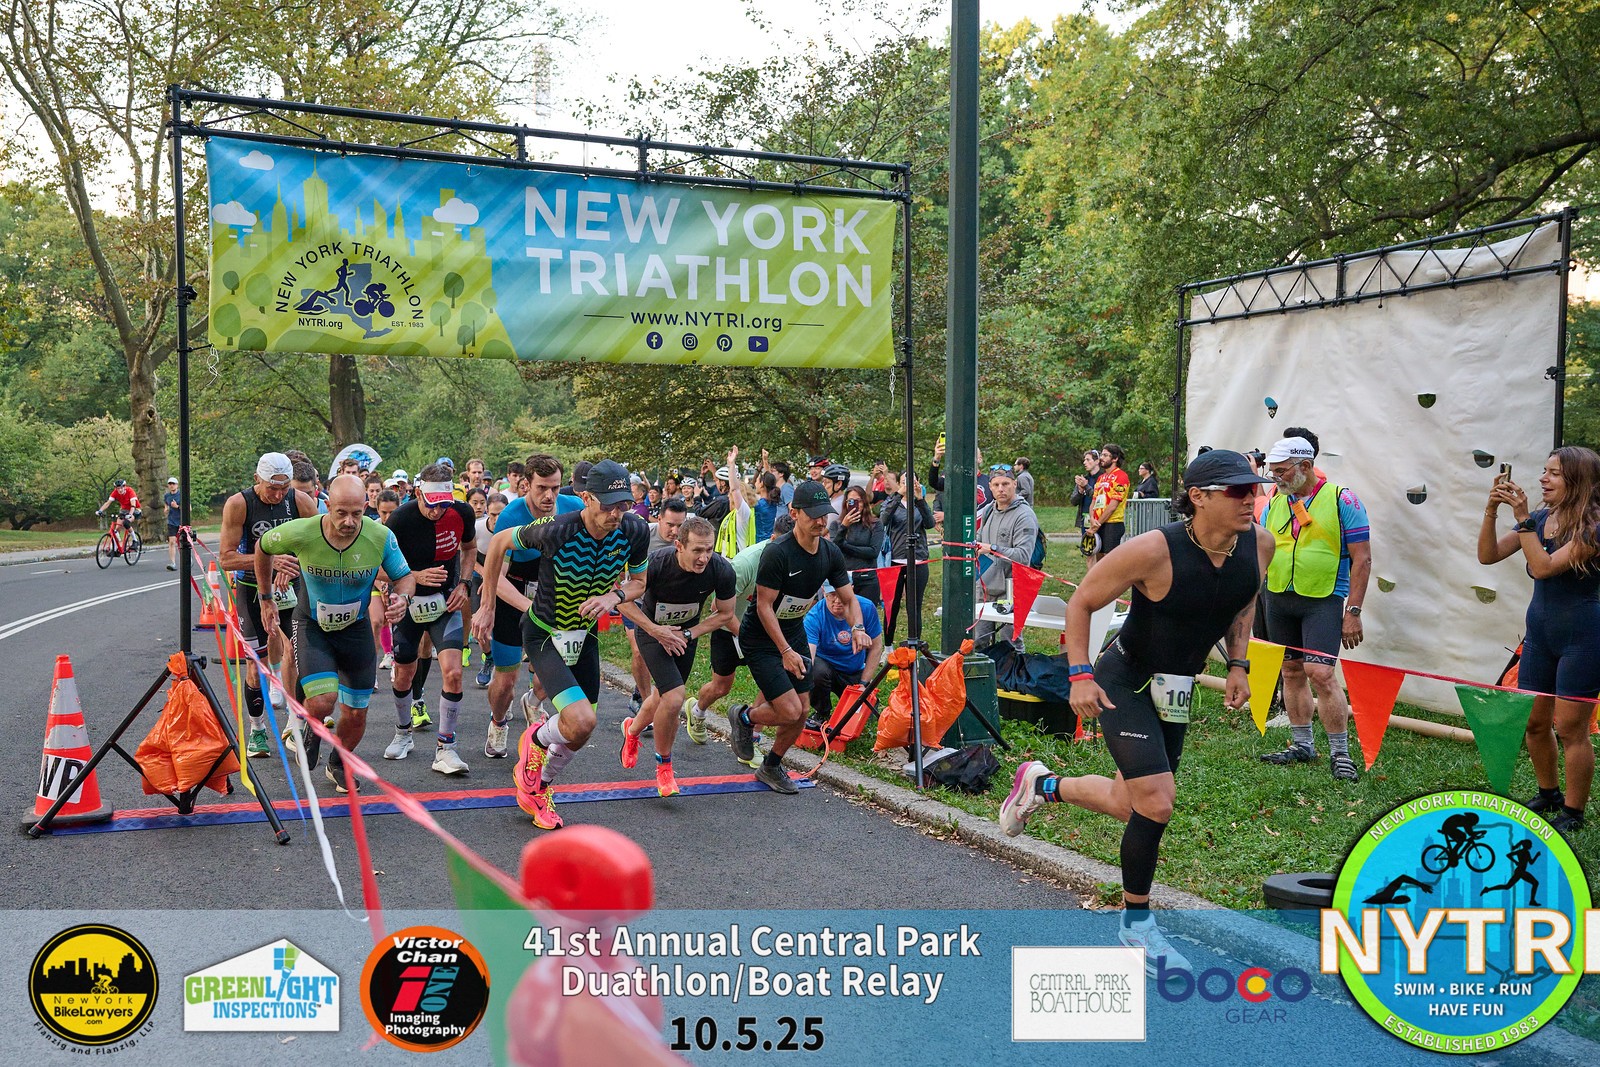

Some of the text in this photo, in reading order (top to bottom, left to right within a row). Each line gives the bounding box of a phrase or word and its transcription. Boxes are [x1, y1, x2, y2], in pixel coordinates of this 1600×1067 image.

[524, 186, 870, 255] NEW YORK
[275, 241, 424, 320] NEW YORK TRIATHLON
[525, 246, 872, 307] TRIATHLON
[298, 317, 343, 329] NYTRI.org
[630, 311, 782, 332] www.NYTRI.org
[307, 565, 373, 579] BROOKLYN
[416, 601, 438, 613] 119
[327, 612, 351, 623] 136
[666, 610, 689, 620] 127
[1119, 731, 1149, 740] SPARX
